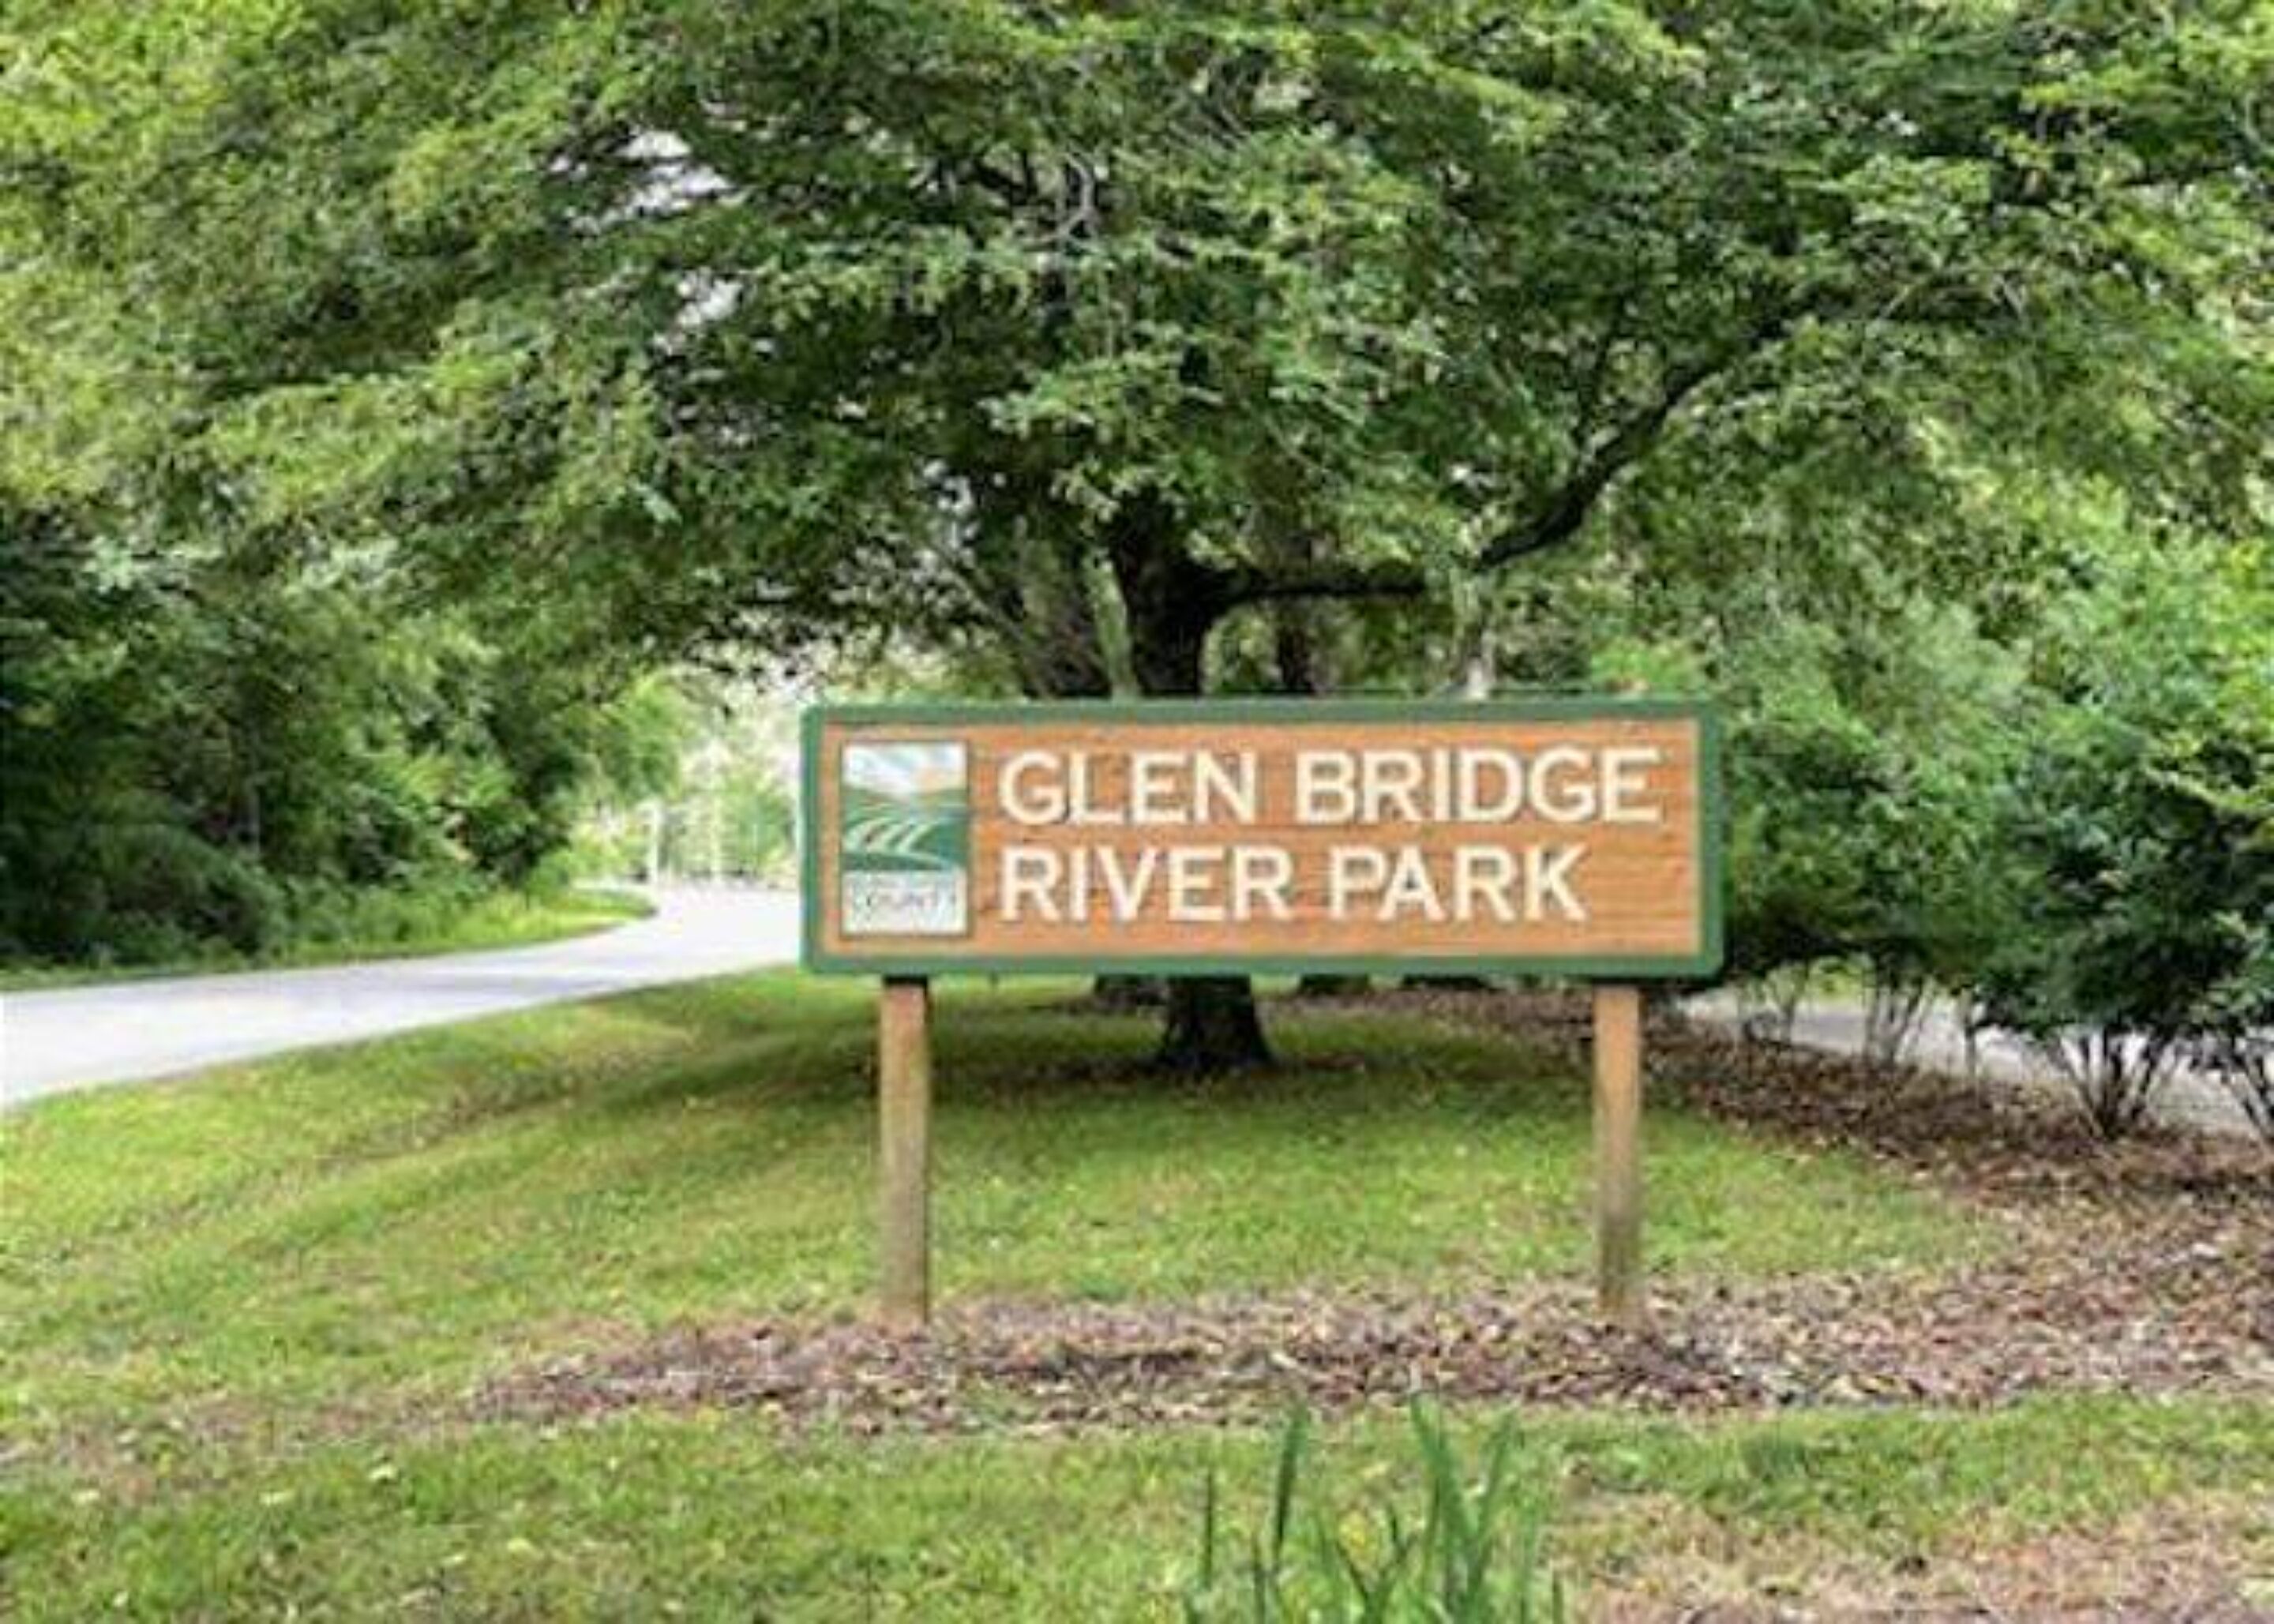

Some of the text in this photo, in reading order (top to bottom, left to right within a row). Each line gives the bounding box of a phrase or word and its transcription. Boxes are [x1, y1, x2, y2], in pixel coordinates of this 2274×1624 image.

[999, 746, 1661, 826] GLEN BRIDGE
[1000, 845, 1586, 921] RIVER PARK
